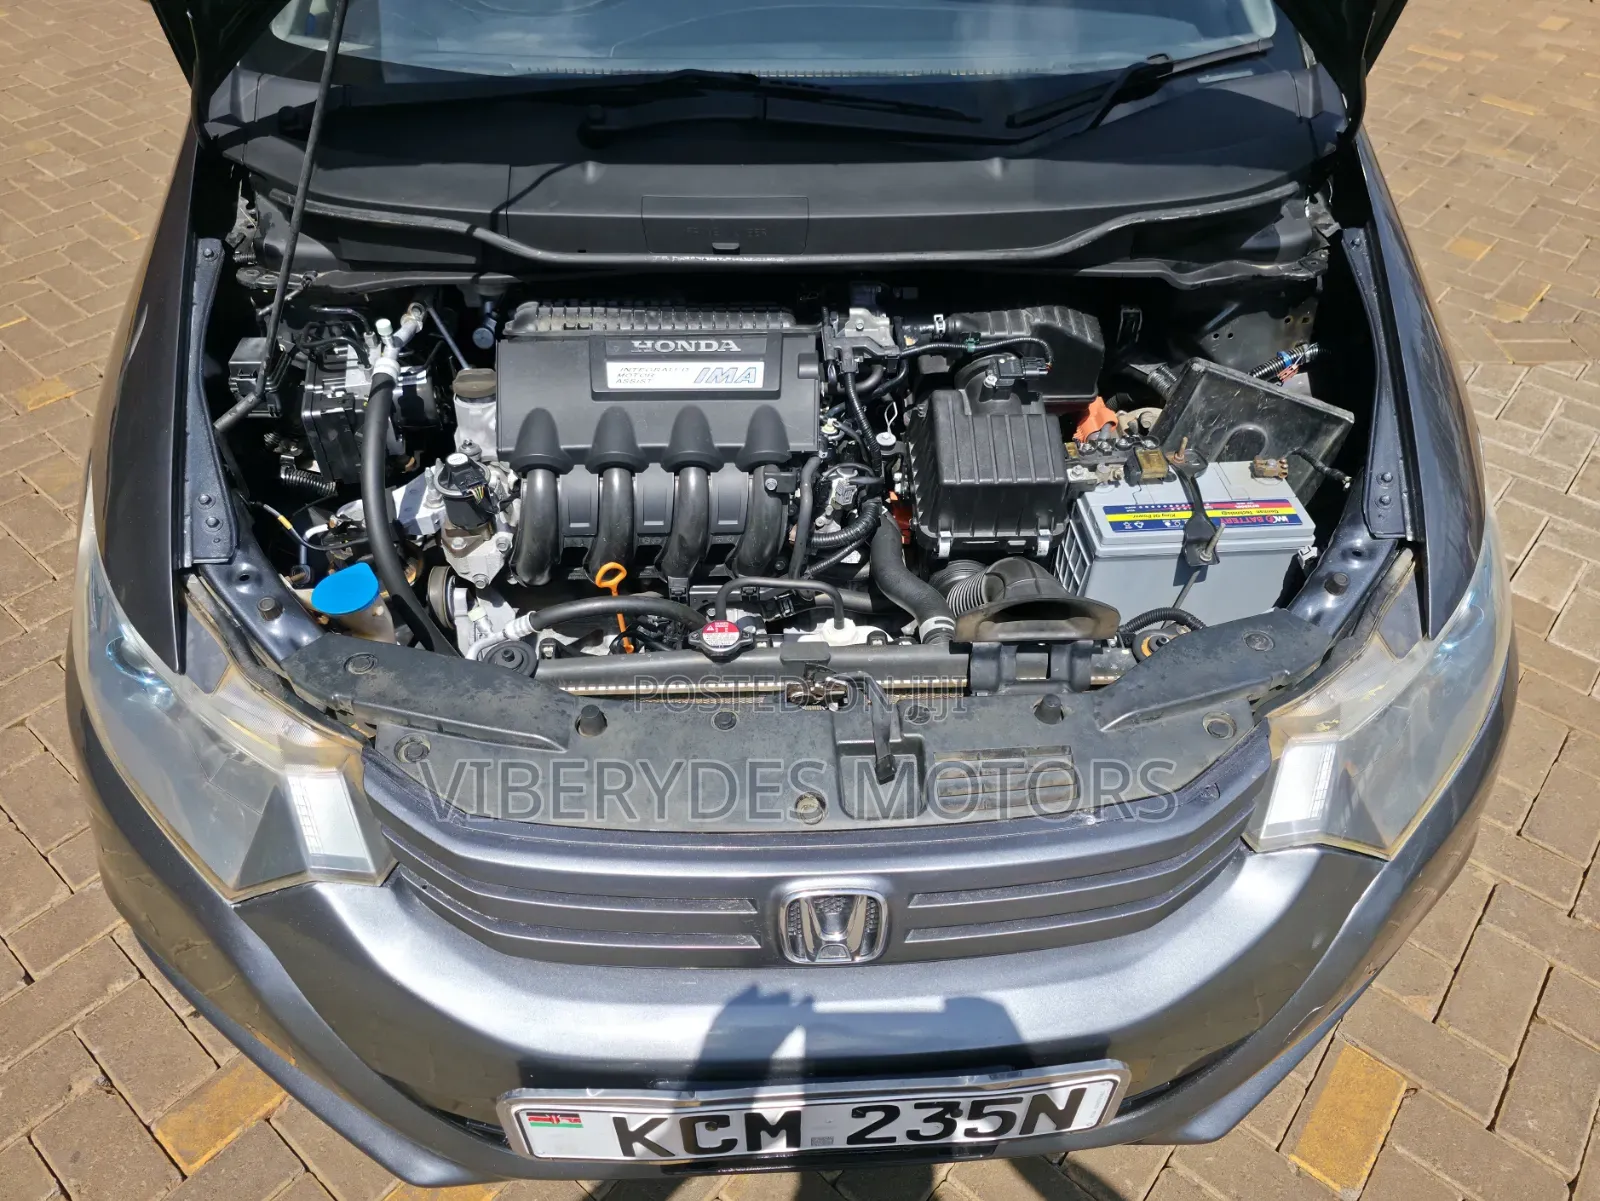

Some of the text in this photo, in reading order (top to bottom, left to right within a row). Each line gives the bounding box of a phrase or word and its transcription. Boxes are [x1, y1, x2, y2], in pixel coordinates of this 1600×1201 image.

[630, 340, 742, 353] HONDA
[693, 366, 757, 384] IMA
[1220, 516, 1264, 525] BATTERY
[612, 1109, 801, 1158] KCM
[846, 1086, 1087, 1147] 235N
